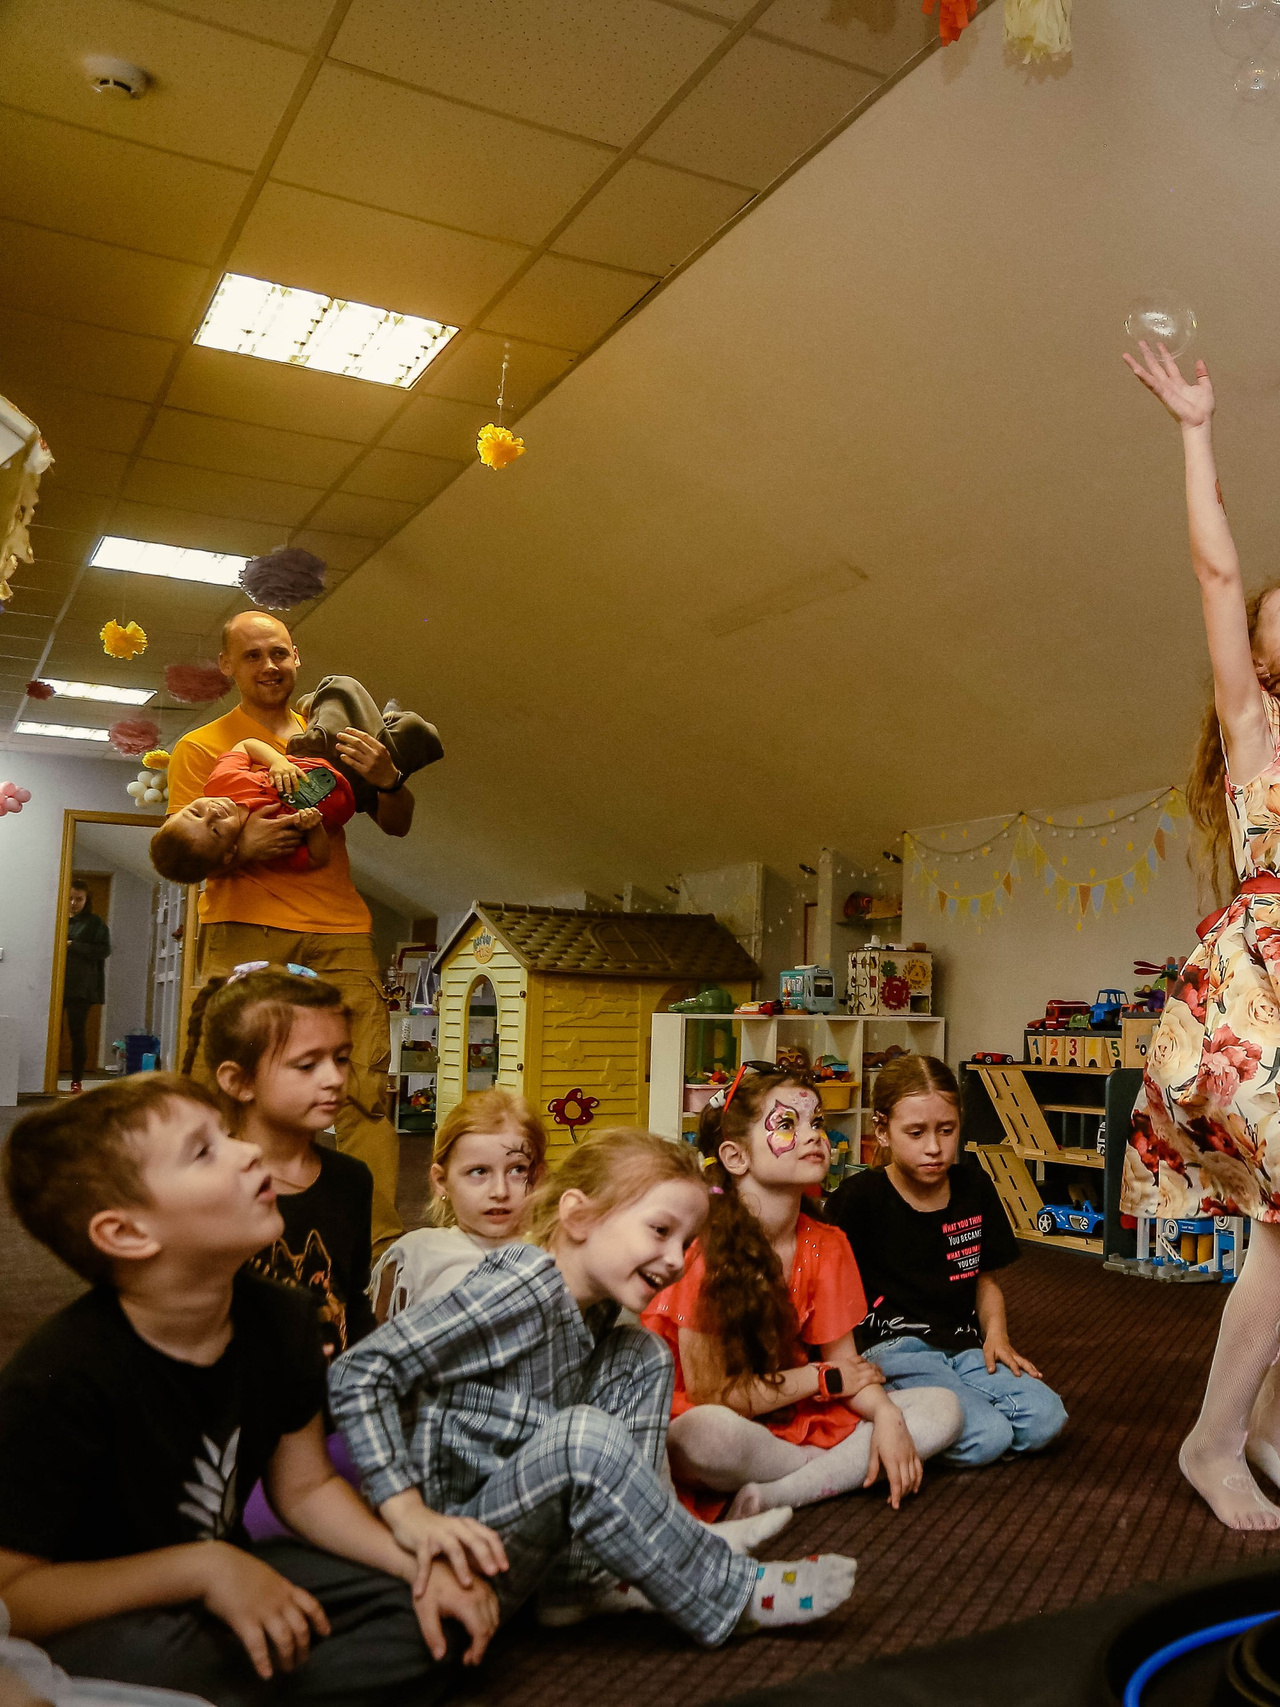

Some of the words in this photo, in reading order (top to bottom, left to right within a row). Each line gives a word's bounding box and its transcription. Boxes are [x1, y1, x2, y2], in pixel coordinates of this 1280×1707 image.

[1033, 1038, 1040, 1055] 1
[1050, 1038, 1059, 1056] 2
[1069, 1038, 1078, 1056] 3
[1110, 1040, 1120, 1058] 5
[946, 1250, 960, 1260] WHAT
[961, 1247, 972, 1256] YOU
[957, 1259, 969, 1269] YOU
